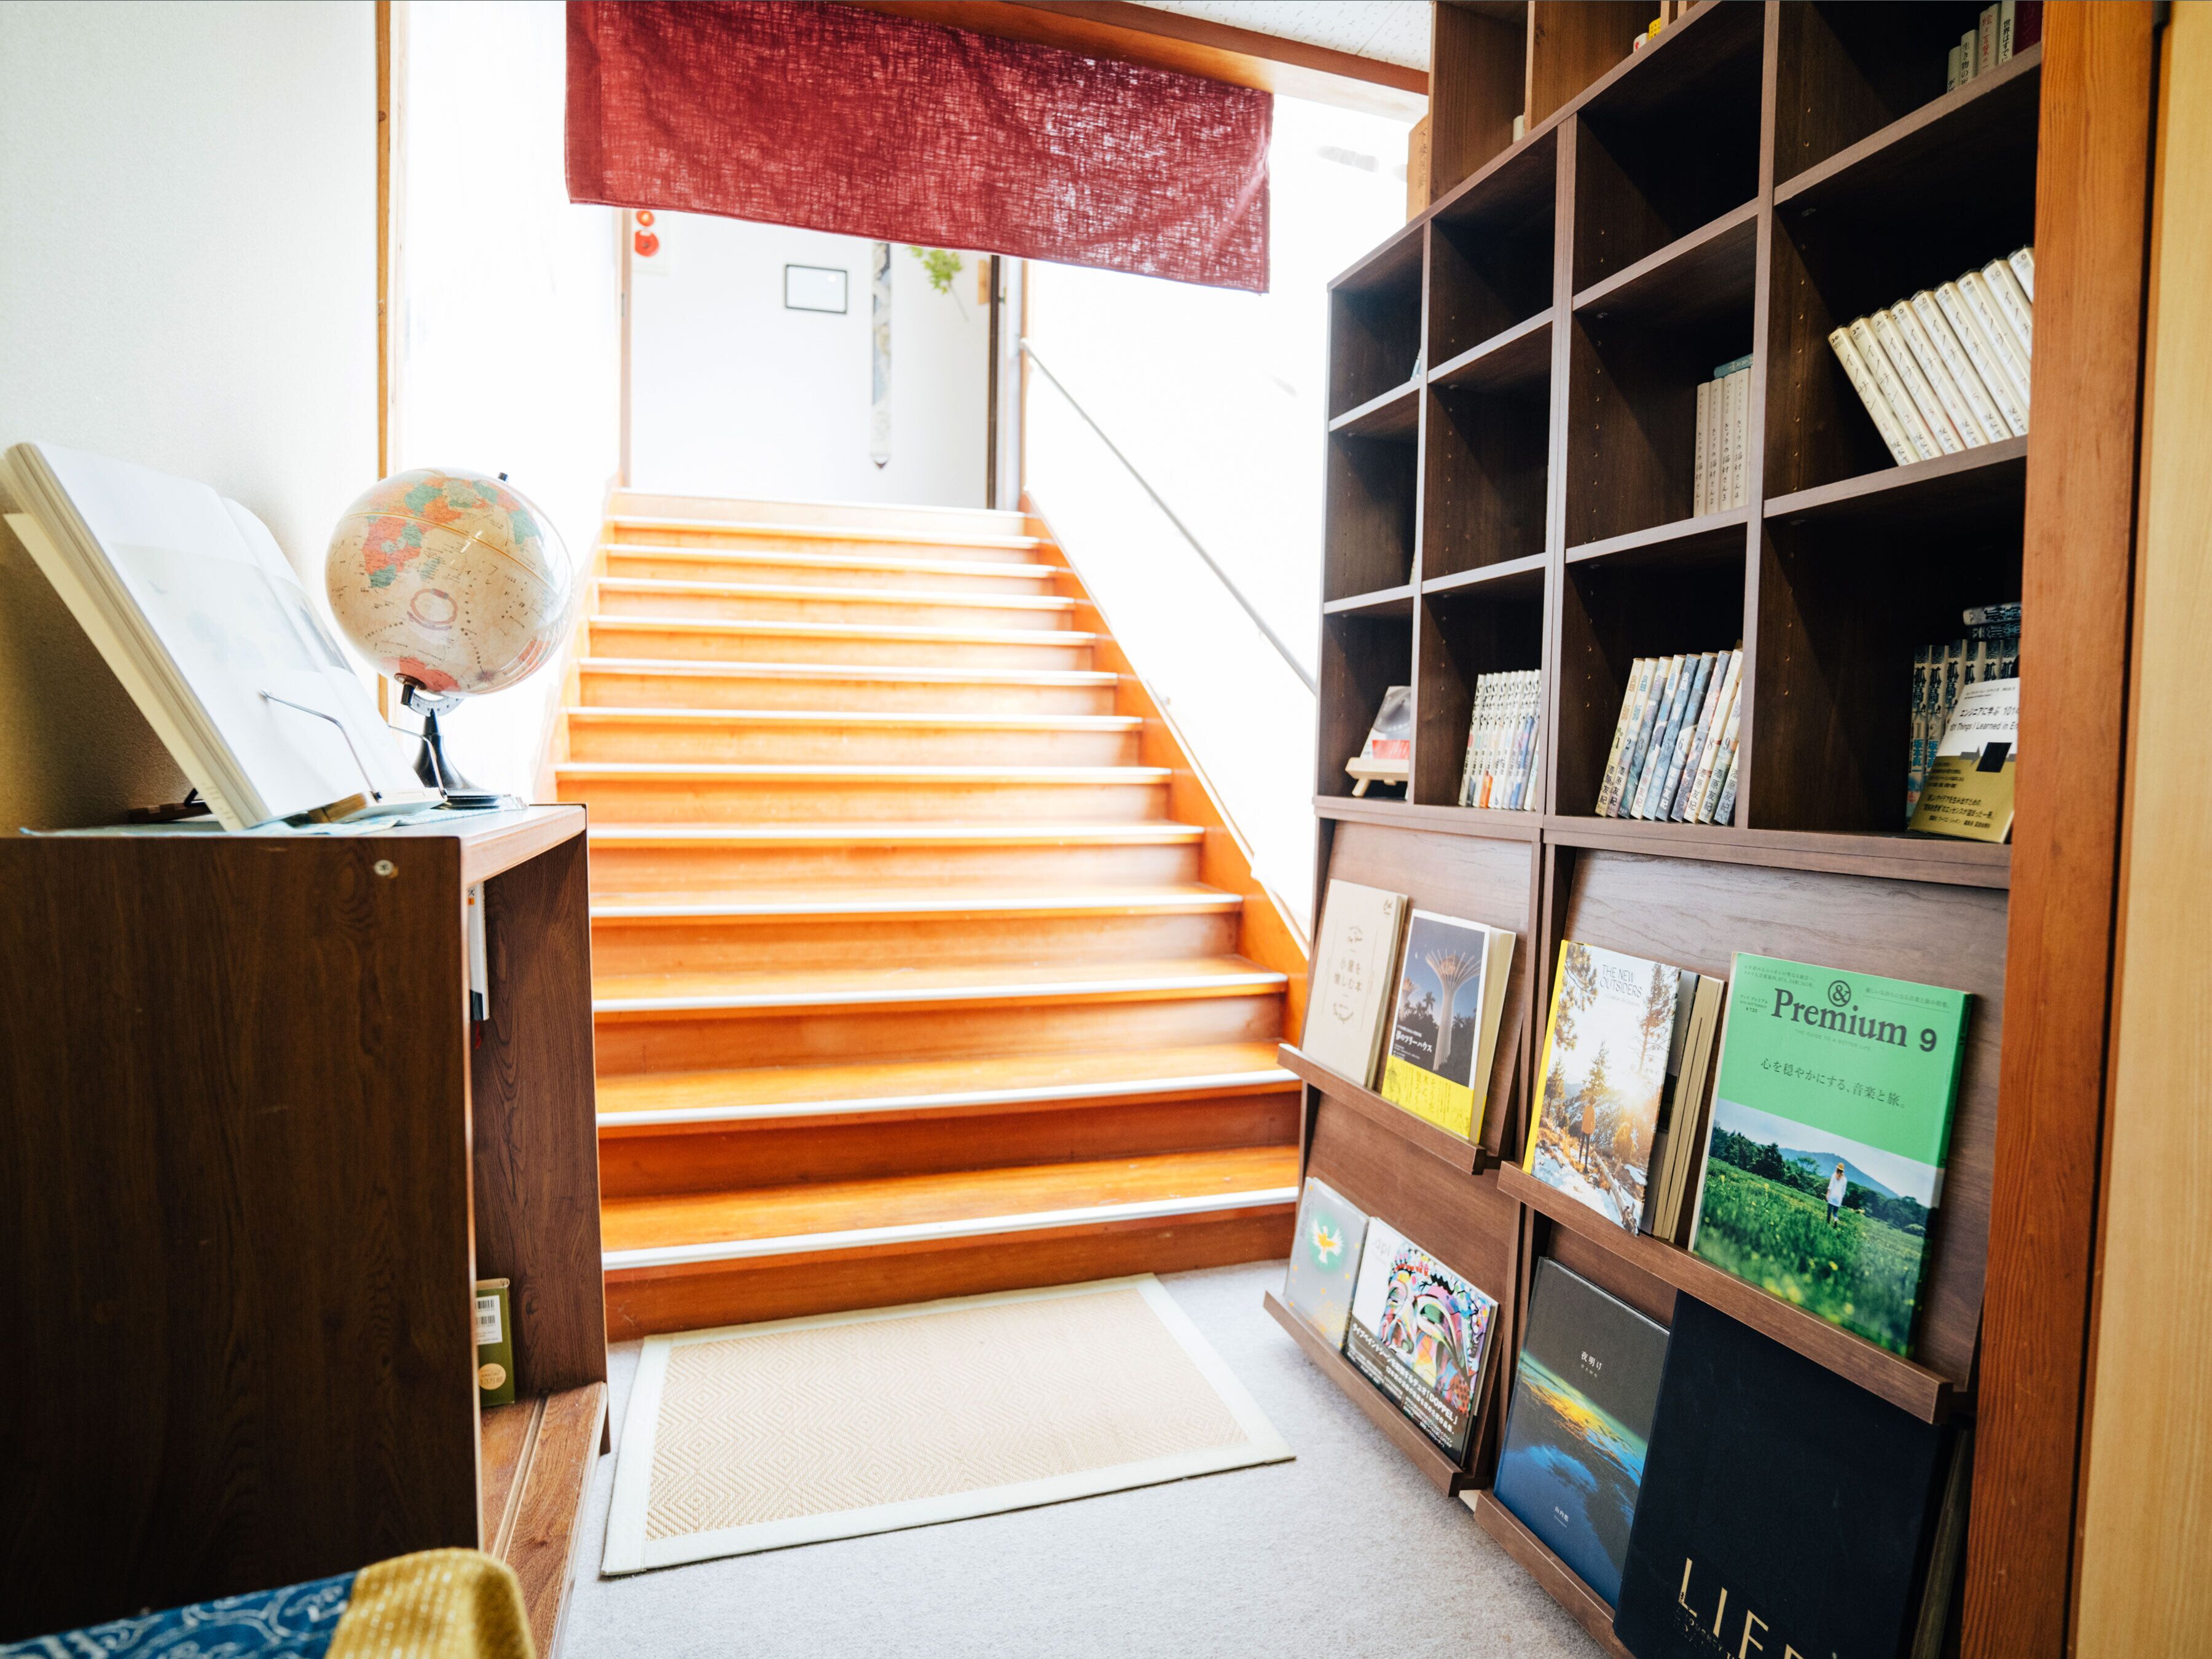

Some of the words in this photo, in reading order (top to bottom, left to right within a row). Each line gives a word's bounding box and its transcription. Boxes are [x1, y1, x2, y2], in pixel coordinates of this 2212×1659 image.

[1991, 270, 2001, 281] 20
[1931, 320, 1966, 380] イノサン
[1954, 312, 1989, 374] イノサン
[1888, 337, 1921, 396] イノサン
[1908, 329, 1942, 389] イノサン
[1845, 354, 1876, 410] イノサン
[1866, 345, 1899, 403] イノサン
[1957, 723, 1972, 732] Things
[1976, 722, 2001, 731] Learned
[1615, 737, 1620, 749] 1
[1625, 737, 1631, 750] 2
[1638, 737, 1644, 750] 3
[1678, 737, 1684, 750] 6
[1695, 737, 1702, 750] 7
[1707, 737, 1714, 751] 8
[1724, 737, 1730, 751] 9
[1610, 766, 1625, 806] 漆原友紀
[1690, 767, 1707, 811] 漆原友紀
[1704, 768, 1724, 812] 漆原友紀
[1602, 964, 1617, 978] THE
[1618, 968, 1634, 983] NEW
[1599, 976, 1642, 998] OUTSIDERS
[1831, 982, 1850, 1005] &
[1771, 987, 1907, 1048] Premium
[1919, 1028, 1937, 1052] 9
[1806, 1030, 1822, 1040] GUIDE
[1760, 1057, 1905, 1108] 心を穏やかにする、音楽と旅。
[1580, 1364, 1598, 1378] DAWN
[1581, 1351, 1602, 1370] 夜明け
[1678, 1557, 1805, 1659] LIF
